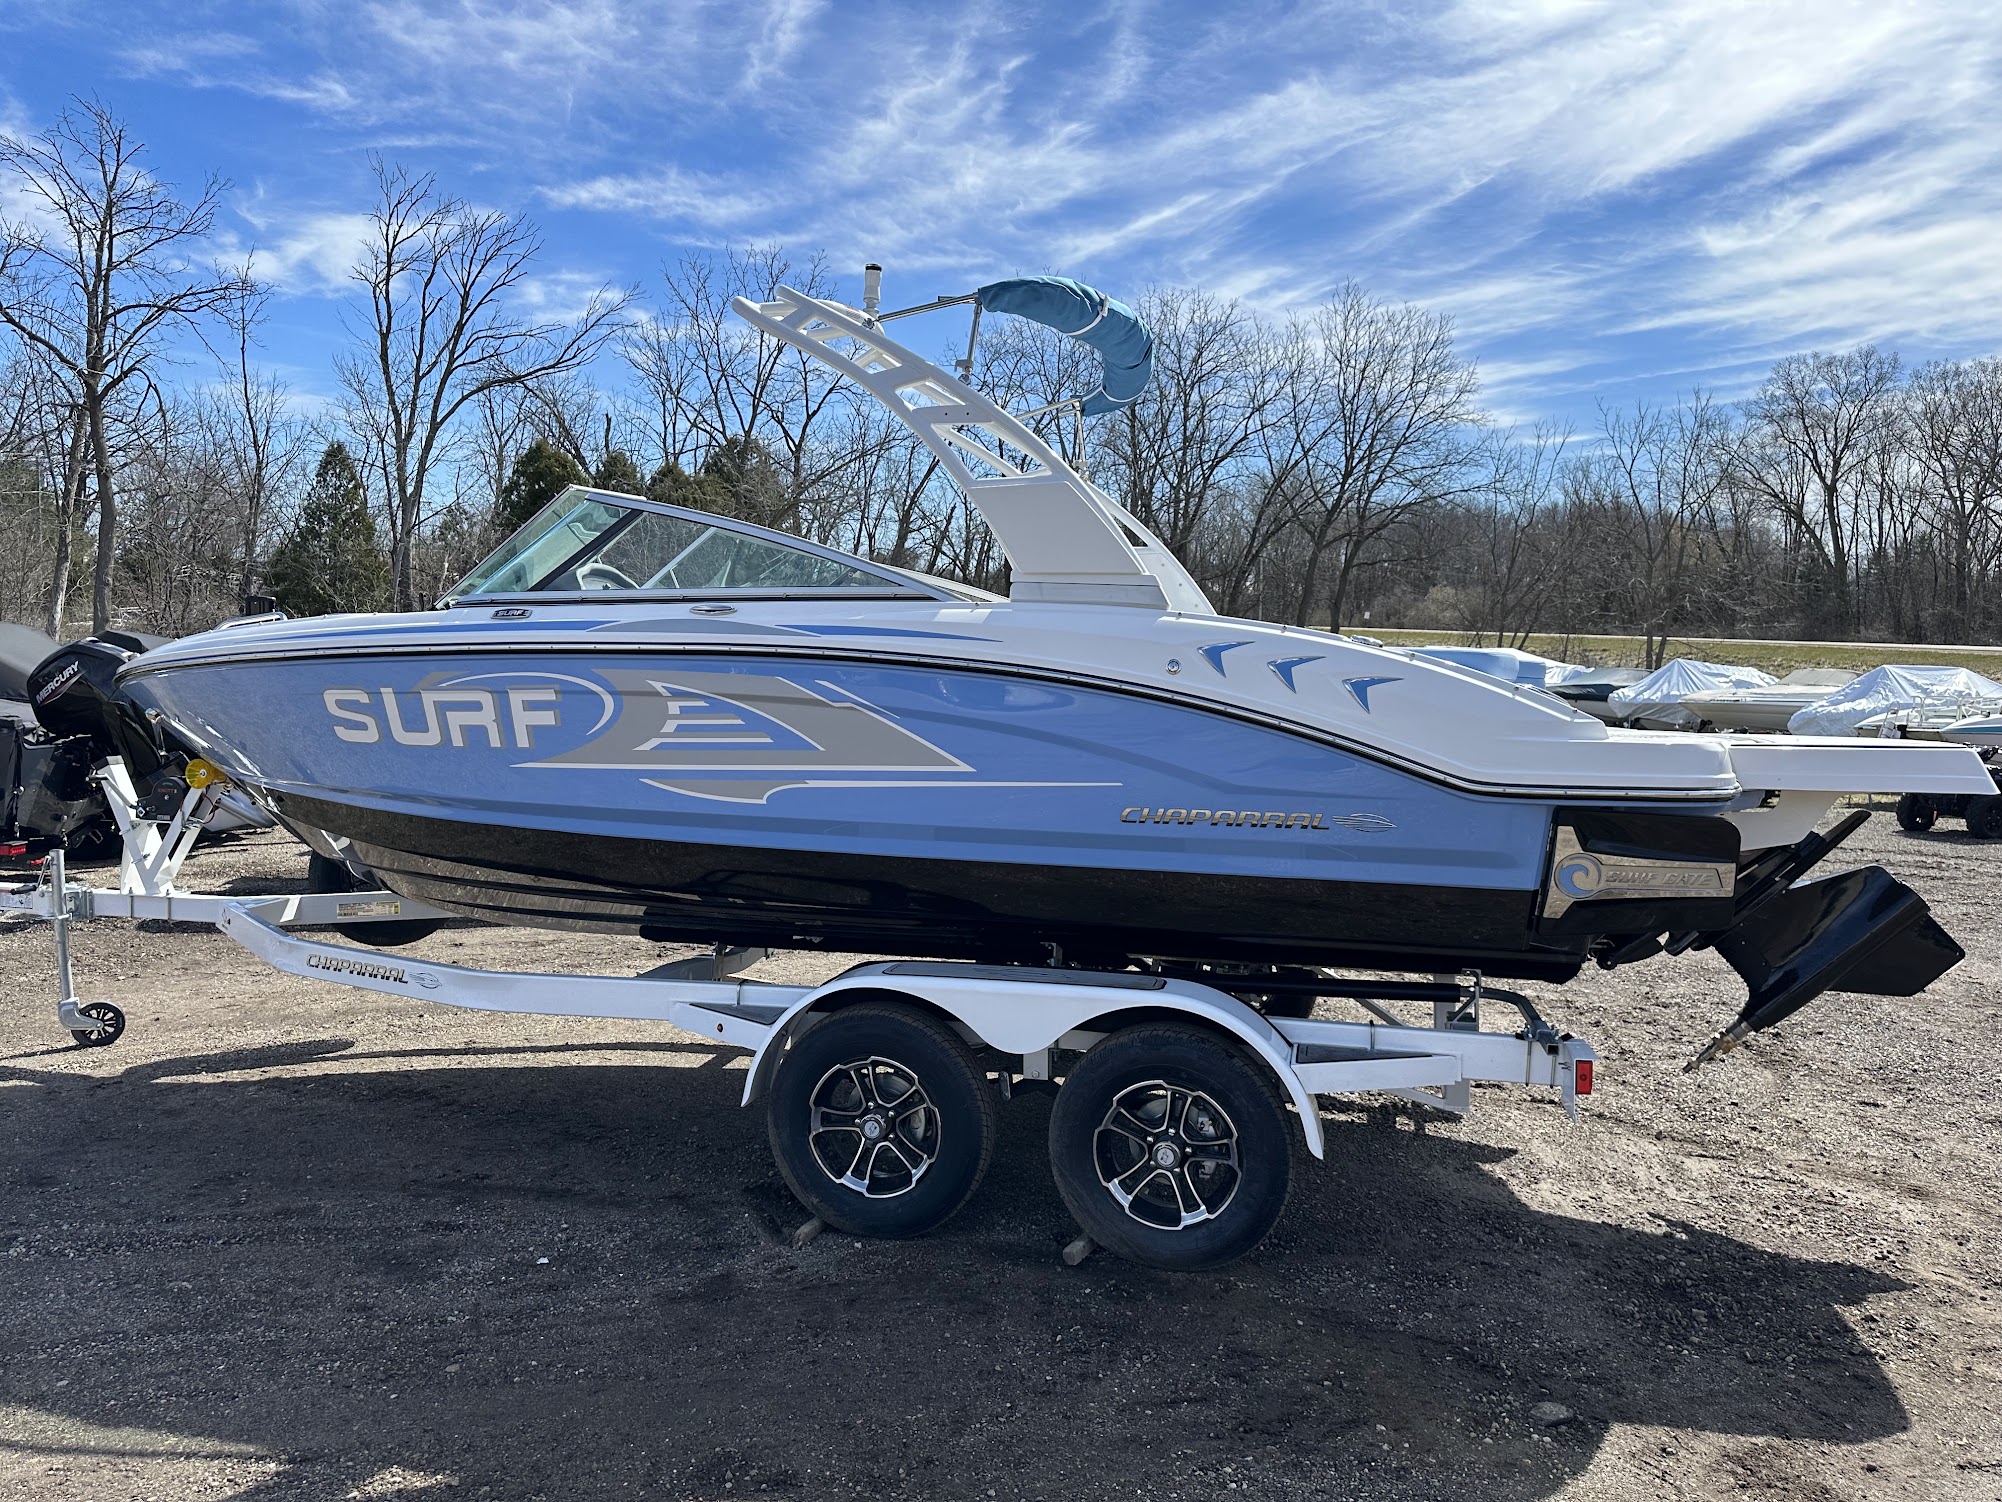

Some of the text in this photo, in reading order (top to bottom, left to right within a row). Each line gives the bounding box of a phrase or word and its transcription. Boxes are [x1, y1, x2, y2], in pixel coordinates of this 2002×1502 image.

[35, 660, 80, 704] MERCURY
[322, 685, 561, 749] SURF
[1119, 806, 1330, 830] CHAPARRAL
[1662, 872, 1715, 885] GATE
[306, 953, 409, 984] CHAPARRAL
